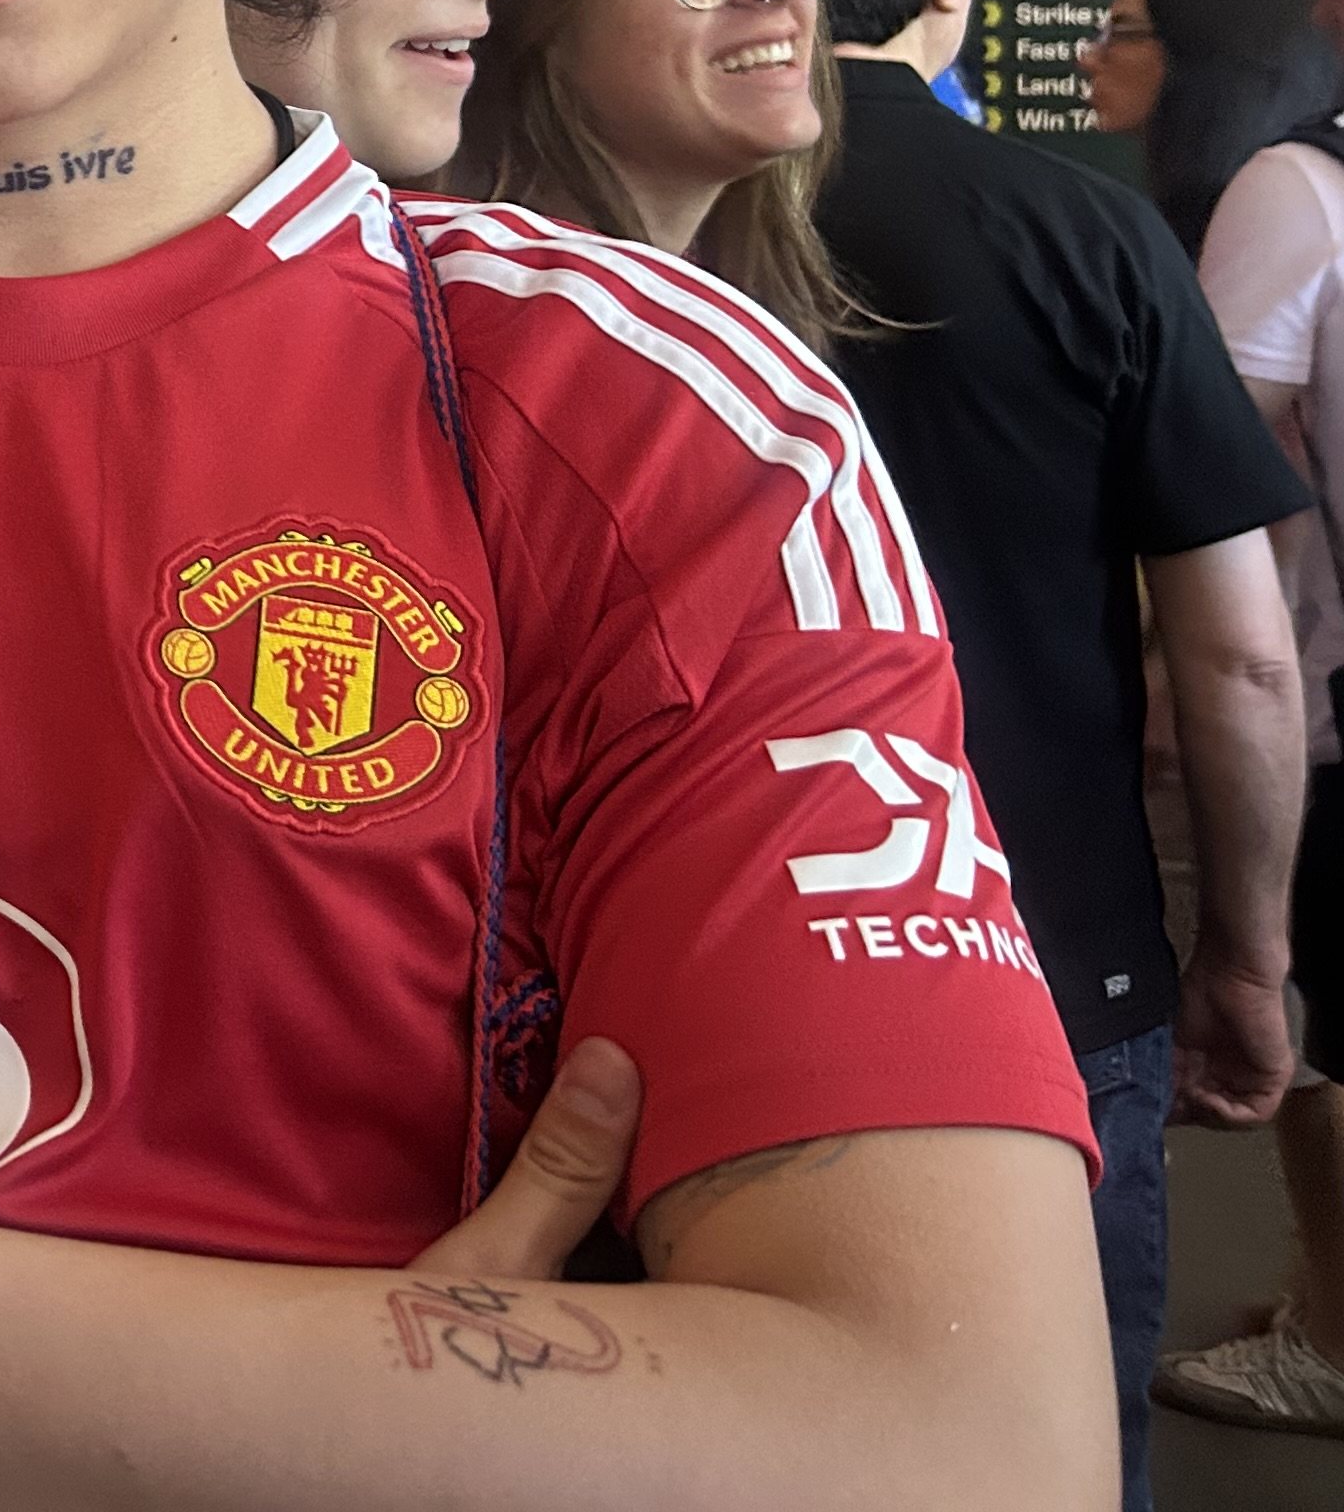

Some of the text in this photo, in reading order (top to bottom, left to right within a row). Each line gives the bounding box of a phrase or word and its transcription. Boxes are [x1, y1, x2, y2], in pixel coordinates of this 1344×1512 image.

[1015, 2, 1112, 30] Strike y
[1016, 37, 1070, 61] Fast
[1016, 73, 1094, 100] Land y
[1016, 108, 1100, 131] Win TA
[60, 146, 136, 184] ivre
[200, 550, 441, 655] MANCHESTER
[224, 728, 395, 794] UNITED
[808, 914, 1042, 980] TECHNO
